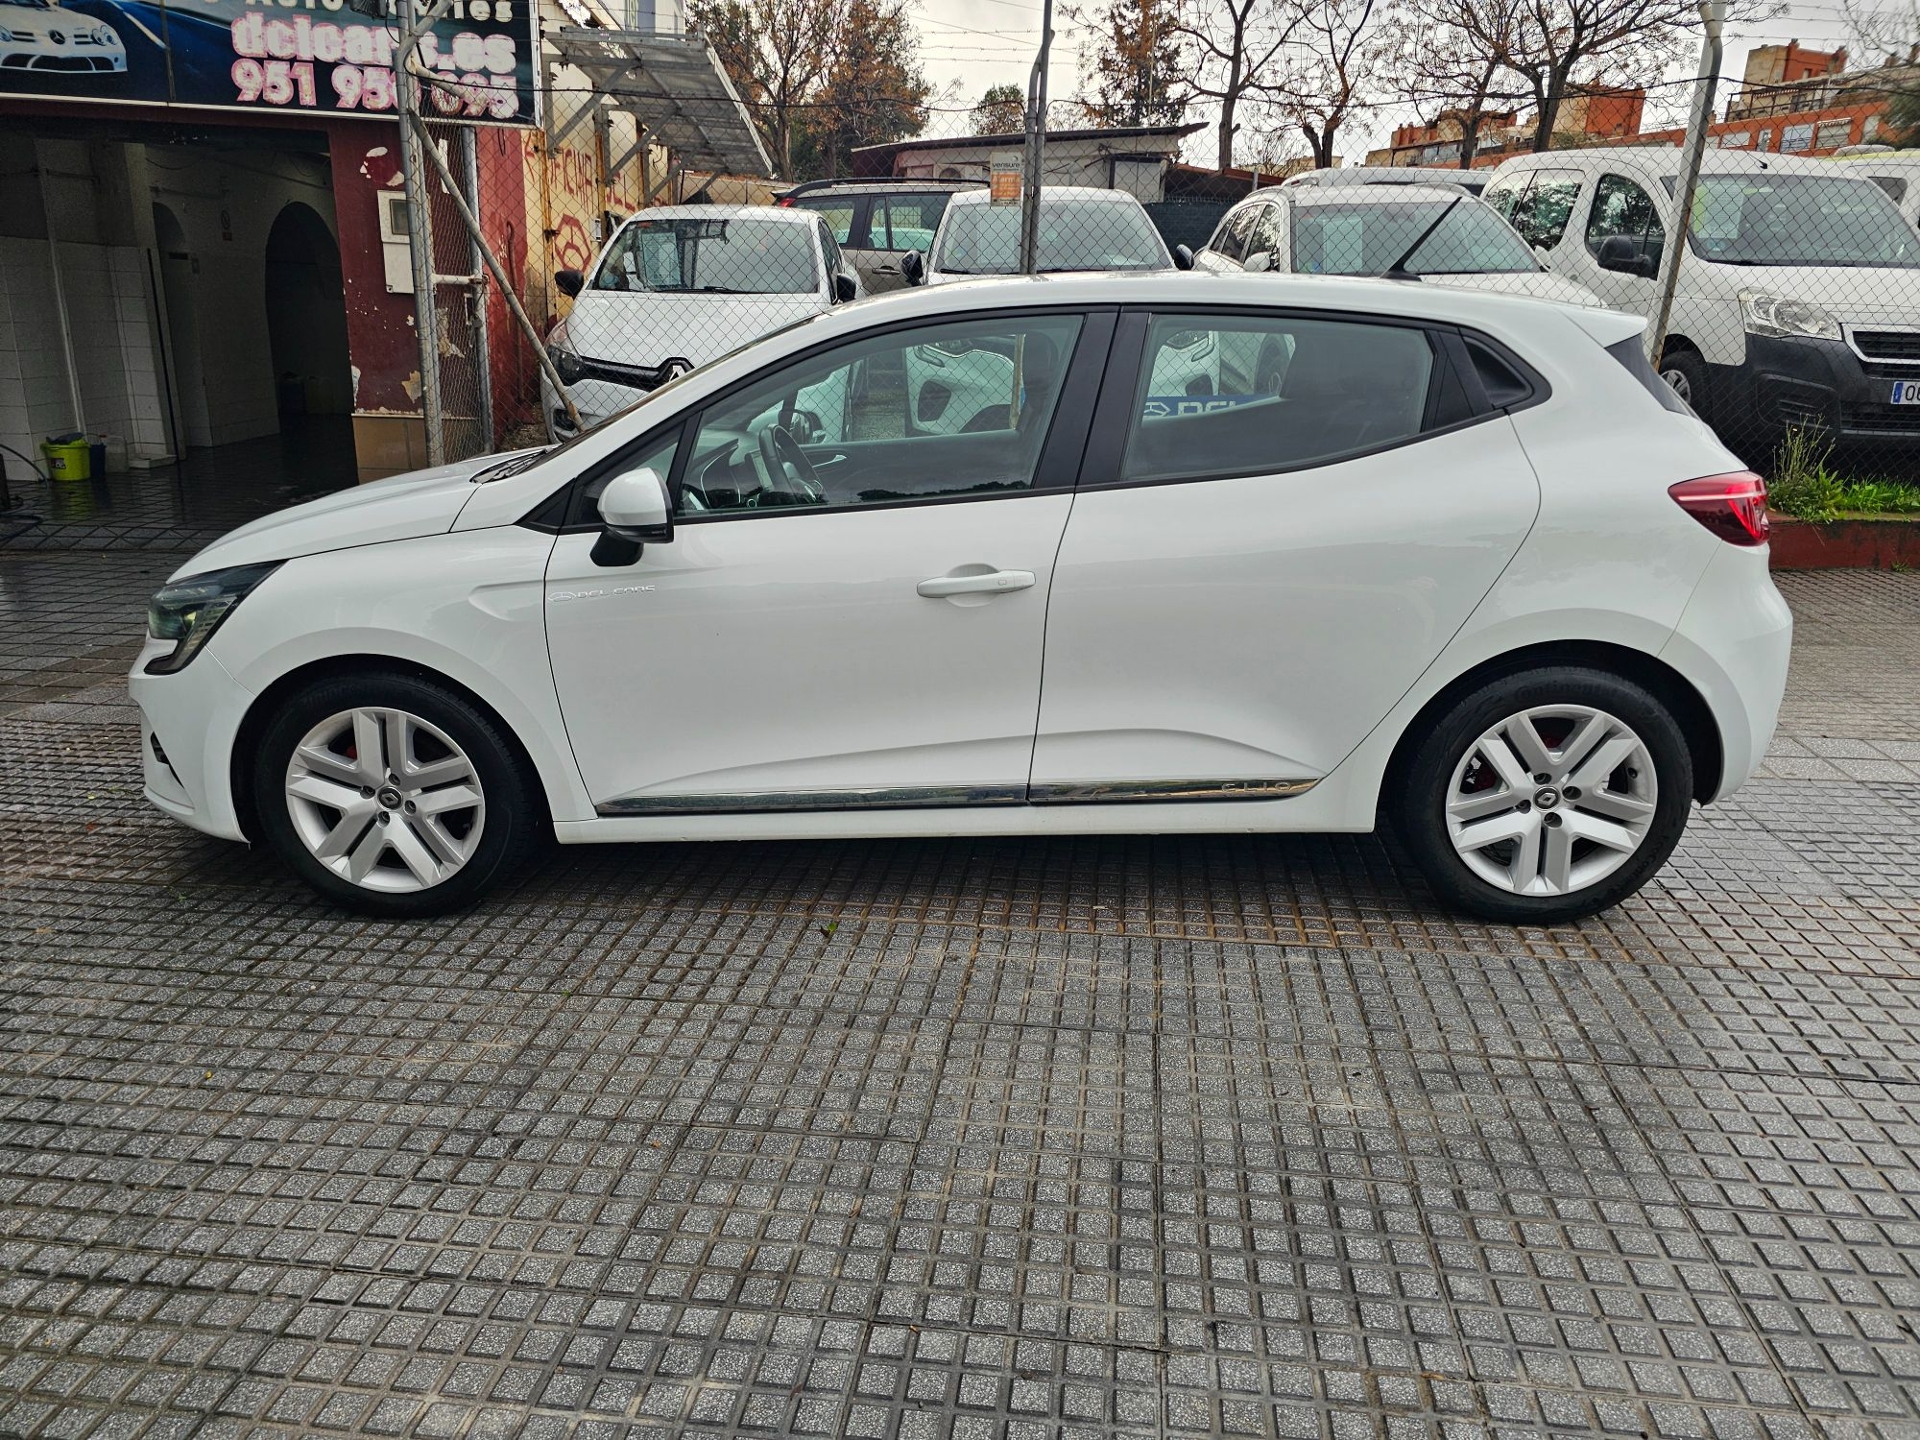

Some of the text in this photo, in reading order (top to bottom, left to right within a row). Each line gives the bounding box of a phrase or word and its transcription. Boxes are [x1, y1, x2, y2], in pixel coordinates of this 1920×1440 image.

[231, 58, 317, 107] 951
[1178, 401, 1237, 416] DC
[1222, 782, 1291, 792] CLIO
